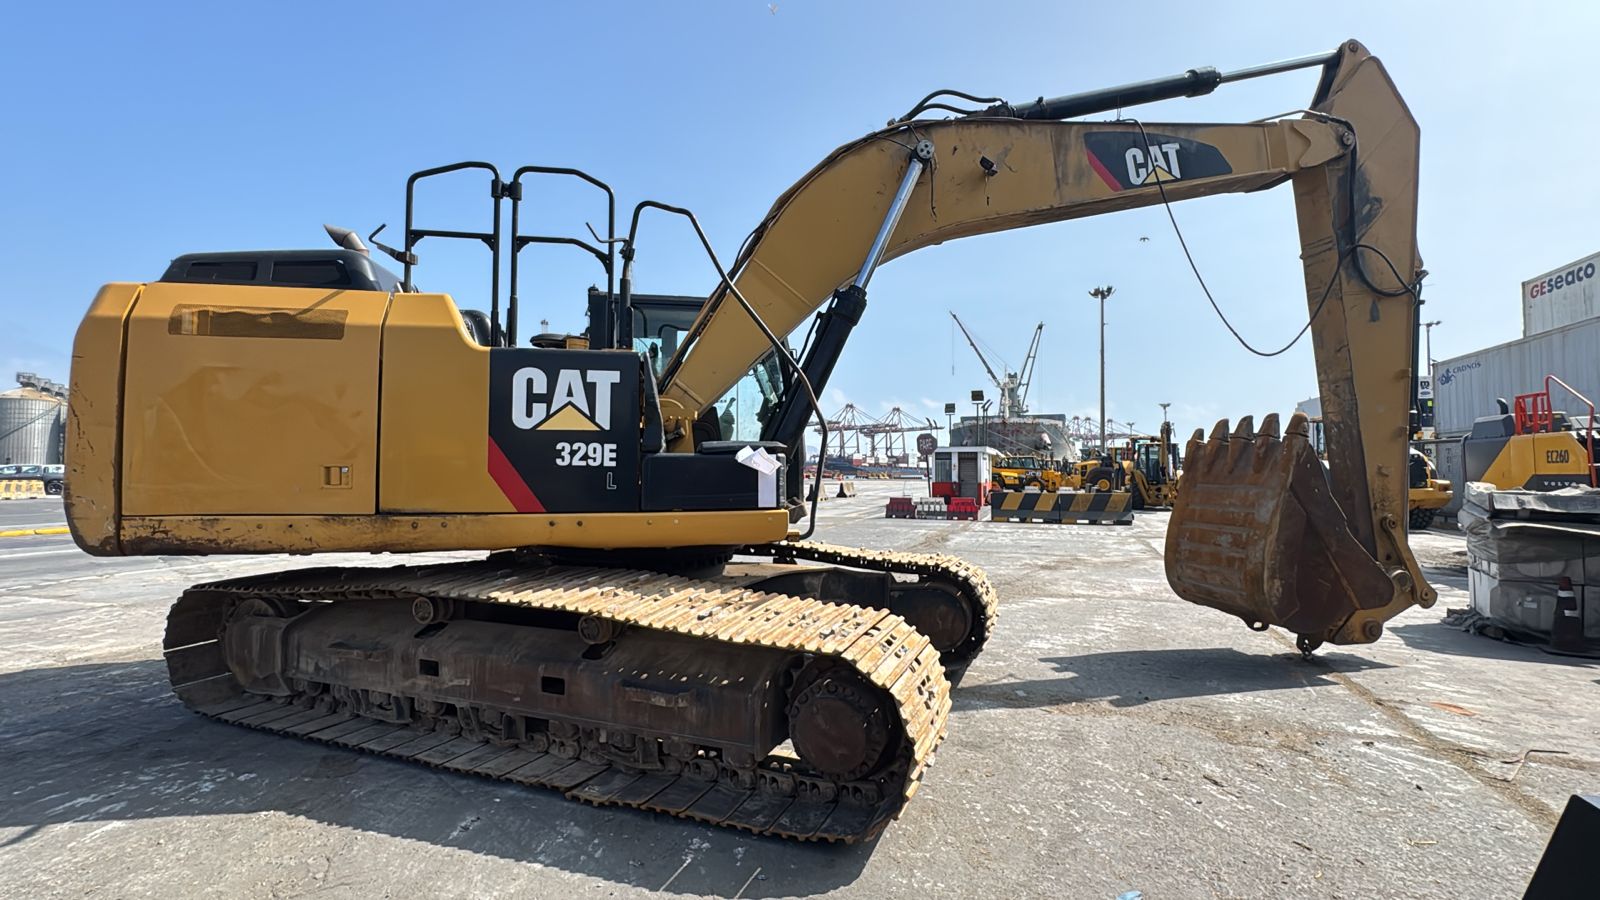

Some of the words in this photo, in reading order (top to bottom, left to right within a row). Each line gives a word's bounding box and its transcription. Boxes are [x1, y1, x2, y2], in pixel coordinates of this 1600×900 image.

[1125, 142, 1182, 186] CAT
[1530, 262, 1596, 298] GEseaco
[512, 367, 621, 431] CAT
[555, 442, 617, 467] 329E
[1546, 449, 1569, 464] EC260
[605, 472, 617, 490] L
